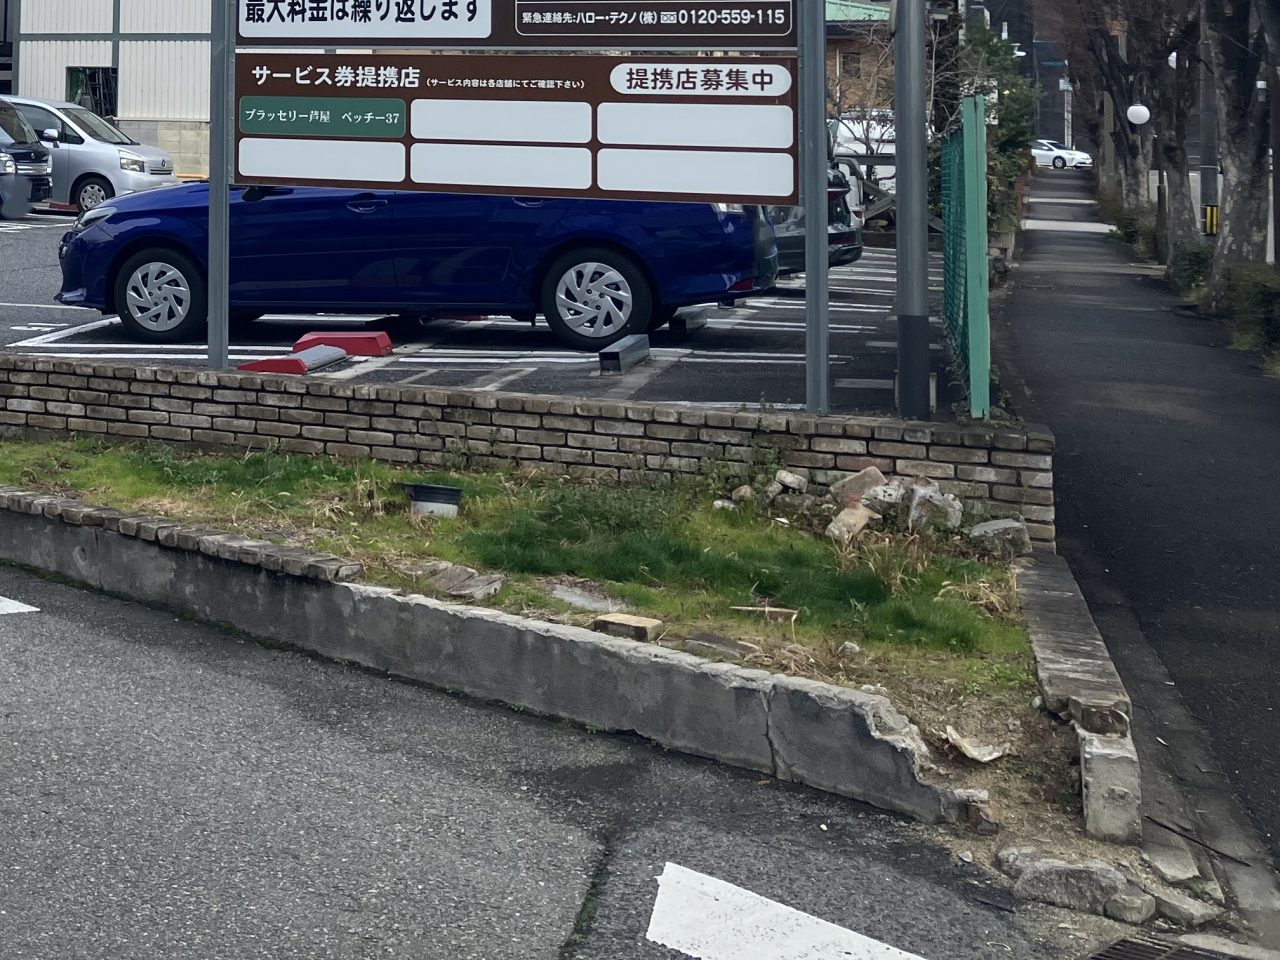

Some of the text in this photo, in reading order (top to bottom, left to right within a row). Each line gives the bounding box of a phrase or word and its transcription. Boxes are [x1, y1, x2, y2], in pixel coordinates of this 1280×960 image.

[678, 9, 786, 25] 0120-559-115
[251, 65, 421, 88] サービス券提携店
[626, 67, 774, 91] 提携店募集中
